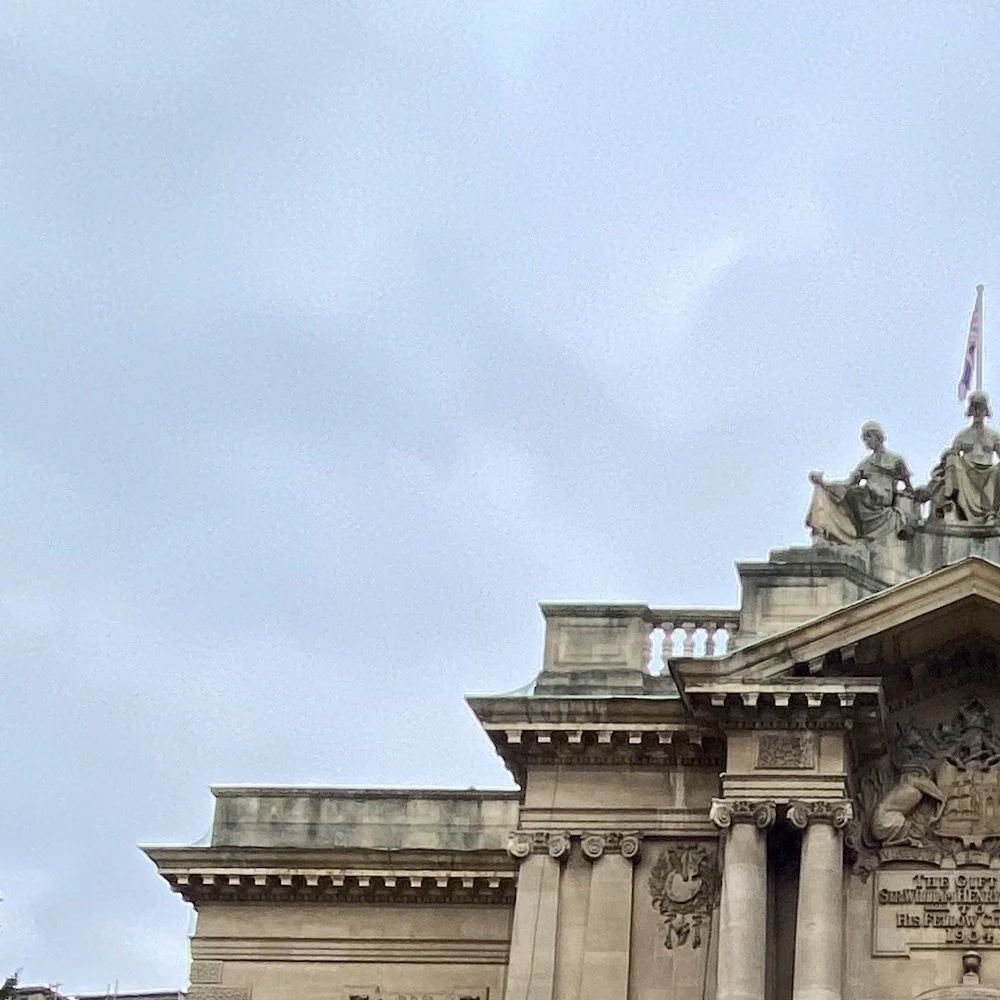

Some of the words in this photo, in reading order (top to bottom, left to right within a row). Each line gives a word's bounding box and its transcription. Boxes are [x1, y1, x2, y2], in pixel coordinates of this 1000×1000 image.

[912, 874, 949, 889] THE
[954, 874, 998, 890] GIFT
[956, 887, 1000, 904] HENRY
[896, 912, 921, 928] HIS
[923, 912, 979, 929] FELLOW
[945, 927, 994, 944] 1904
